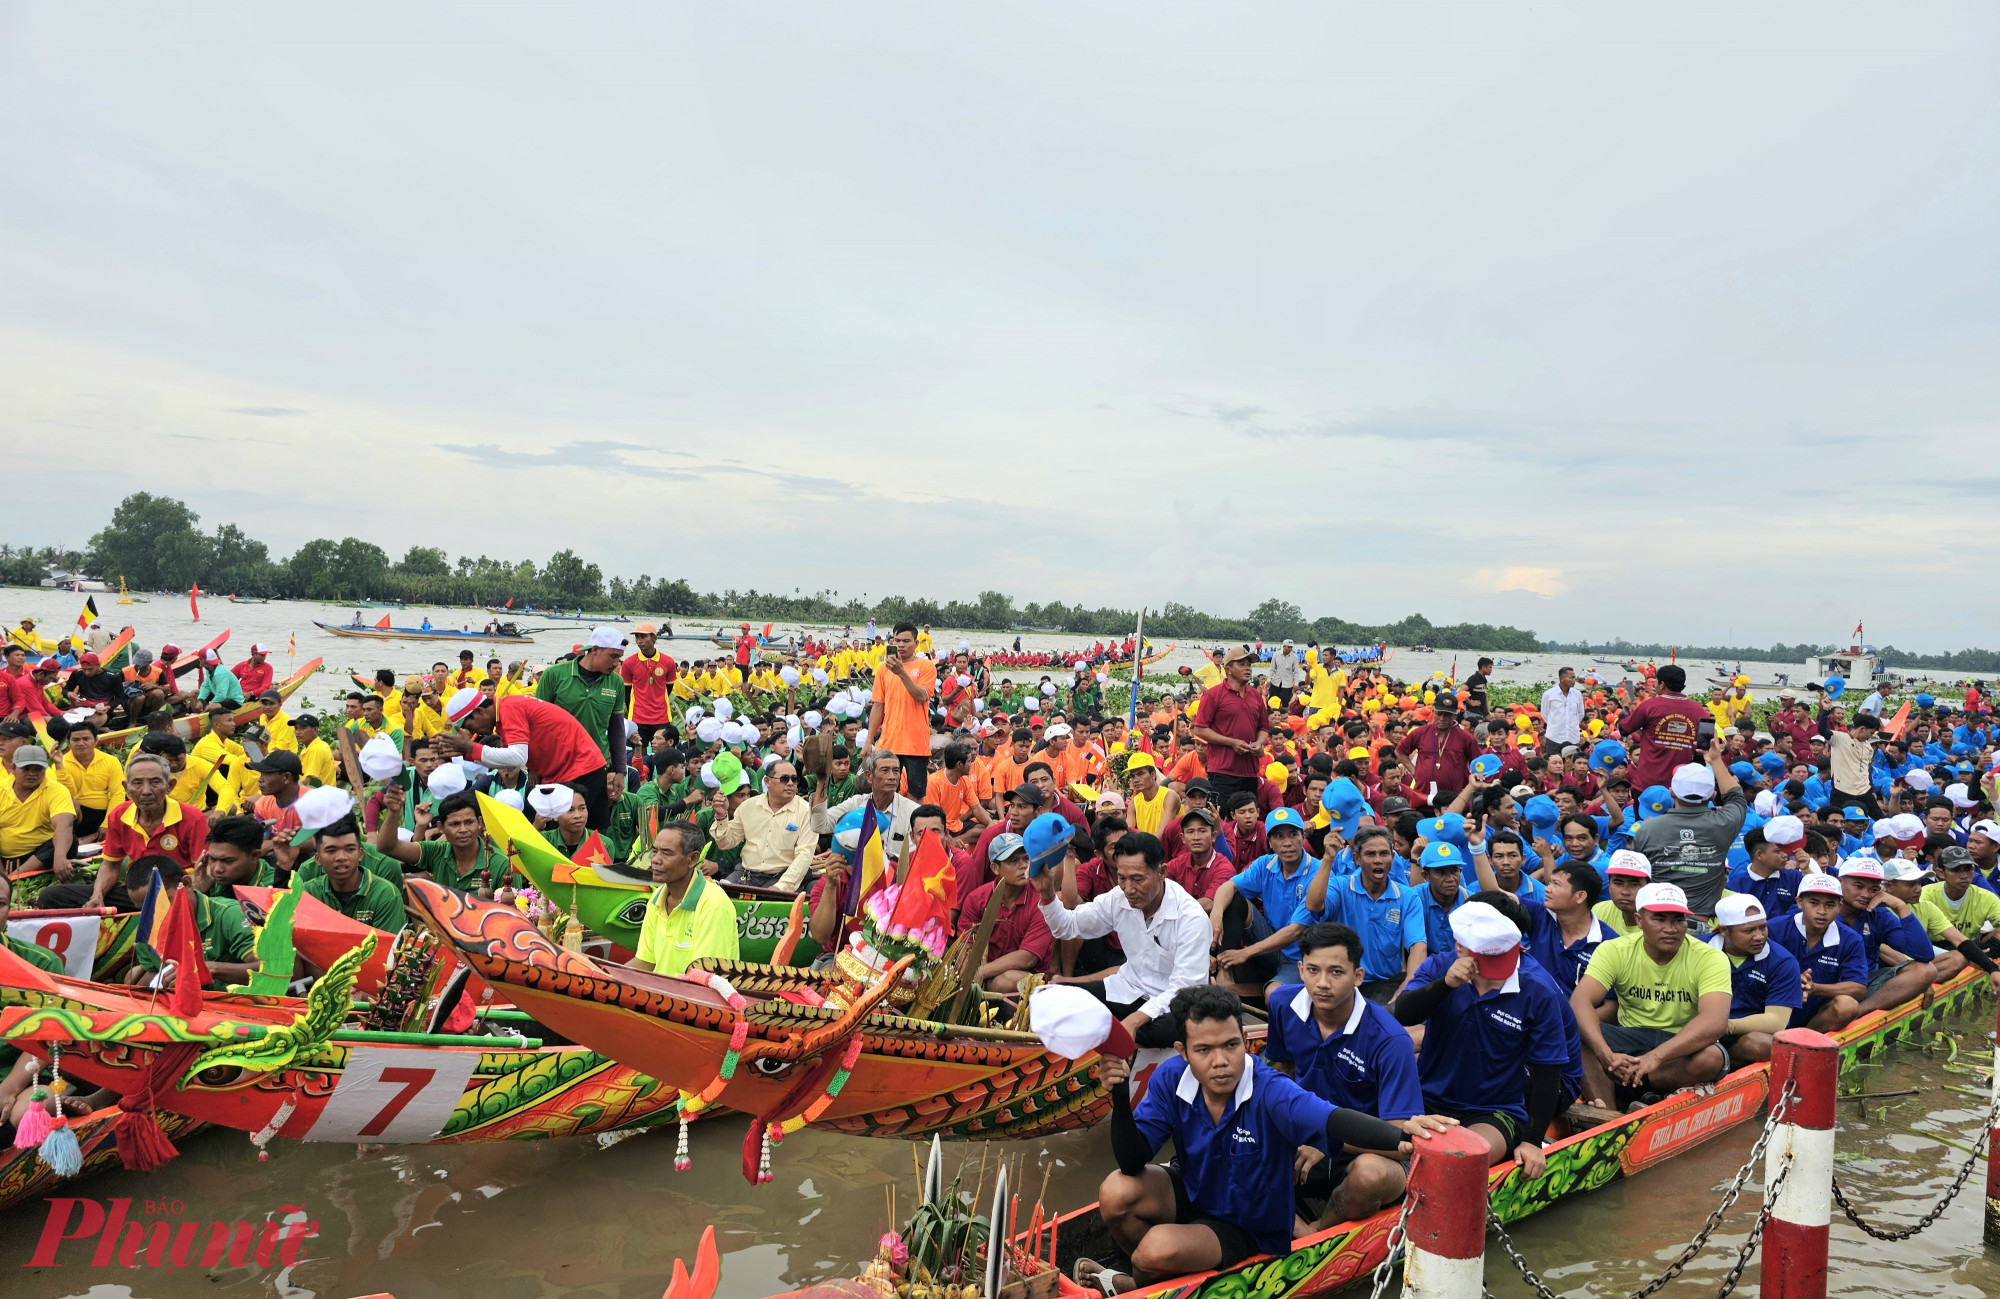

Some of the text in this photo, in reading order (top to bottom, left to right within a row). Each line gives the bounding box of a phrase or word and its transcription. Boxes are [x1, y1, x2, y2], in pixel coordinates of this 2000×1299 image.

[1629, 984, 1693, 1005] CHÙA RẠCH TÌA
[357, 1067, 437, 1136] 7
